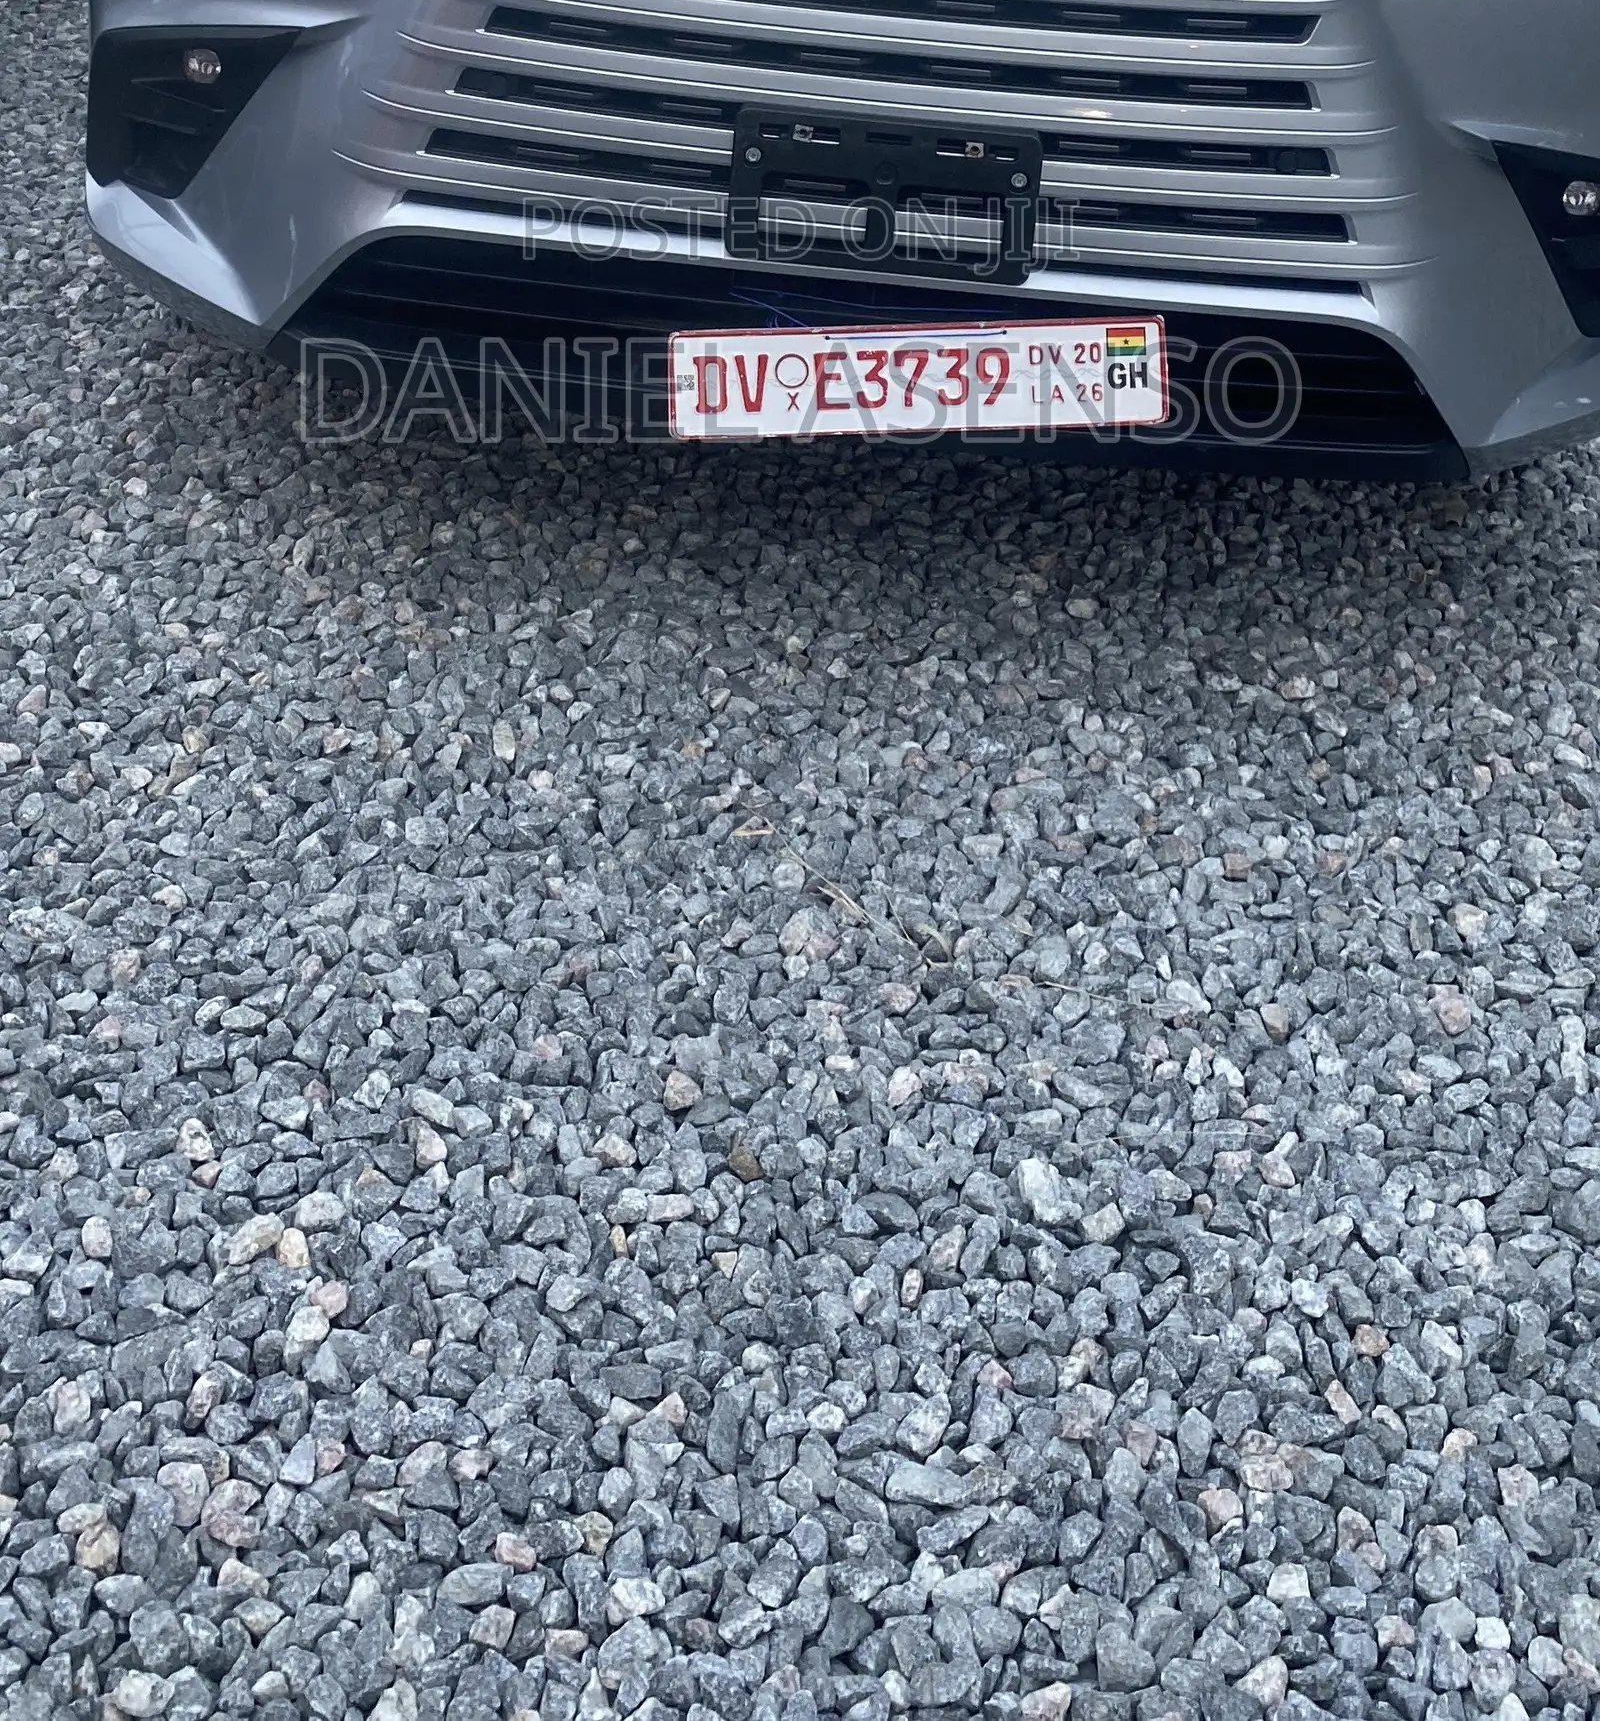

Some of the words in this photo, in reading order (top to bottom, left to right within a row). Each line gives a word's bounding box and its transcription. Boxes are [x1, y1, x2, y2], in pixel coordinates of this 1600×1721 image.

[1028, 345, 1062, 365] DV
[1073, 342, 1101, 364] 20
[692, 353, 769, 414] DV
[813, 346, 1010, 411] E3739
[1107, 362, 1148, 390] GH
[1031, 384, 1065, 404] LA
[1075, 382, 1104, 403] 26
